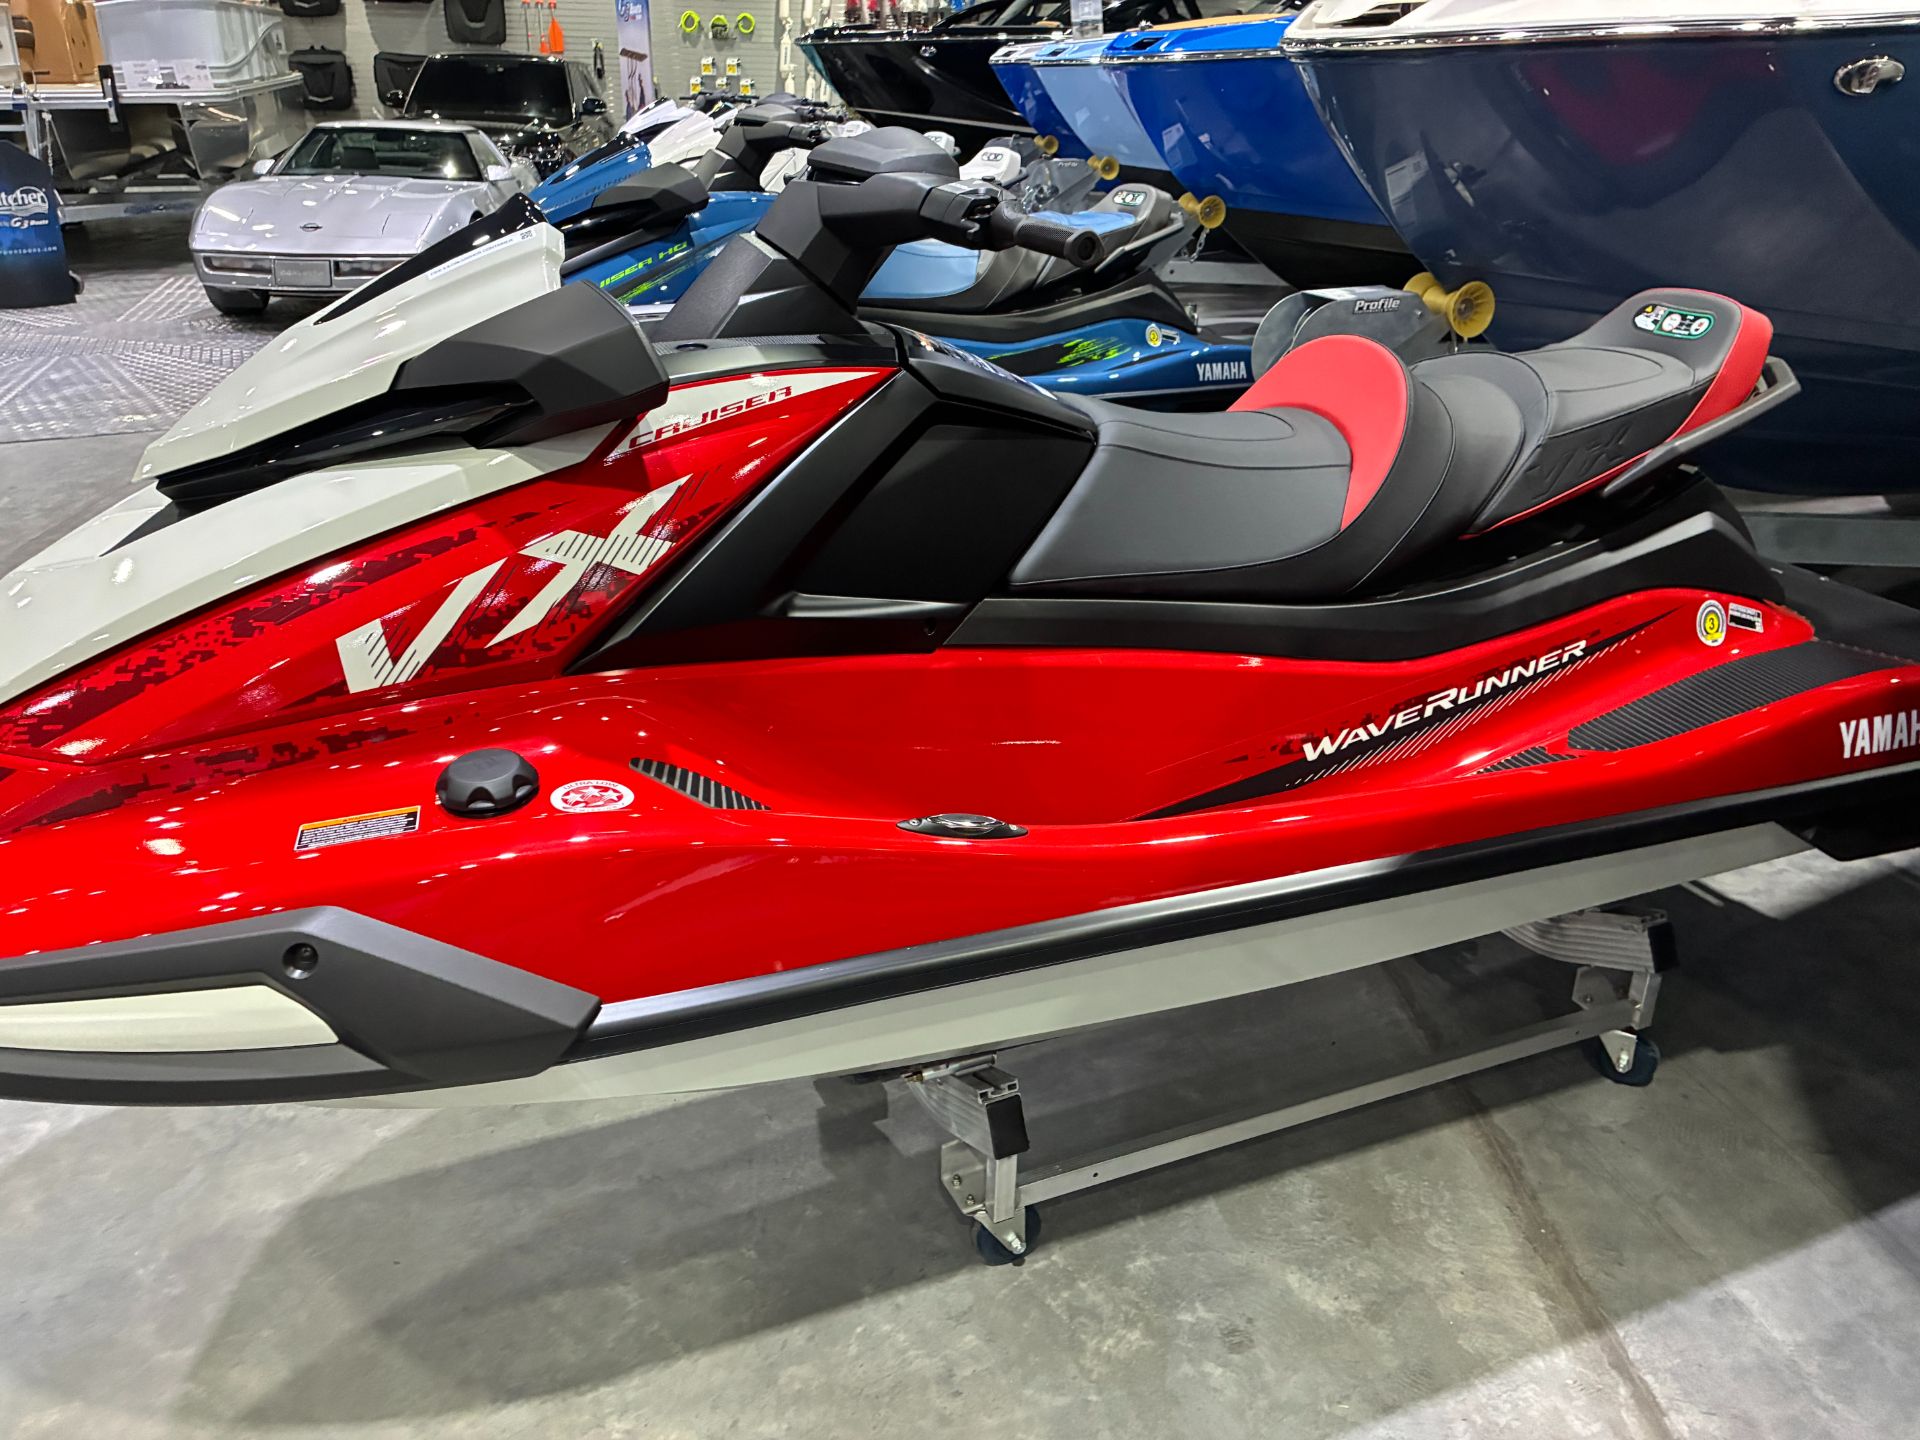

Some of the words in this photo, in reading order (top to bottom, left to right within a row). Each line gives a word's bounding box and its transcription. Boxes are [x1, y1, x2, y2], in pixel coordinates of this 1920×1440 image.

[1354, 297, 1400, 312] Profile
[1196, 361, 1247, 382] YAMAHA
[629, 385, 792, 449] CRUISER
[335, 473, 694, 694] VX
[1302, 640, 1588, 762] WAVERUNNER
